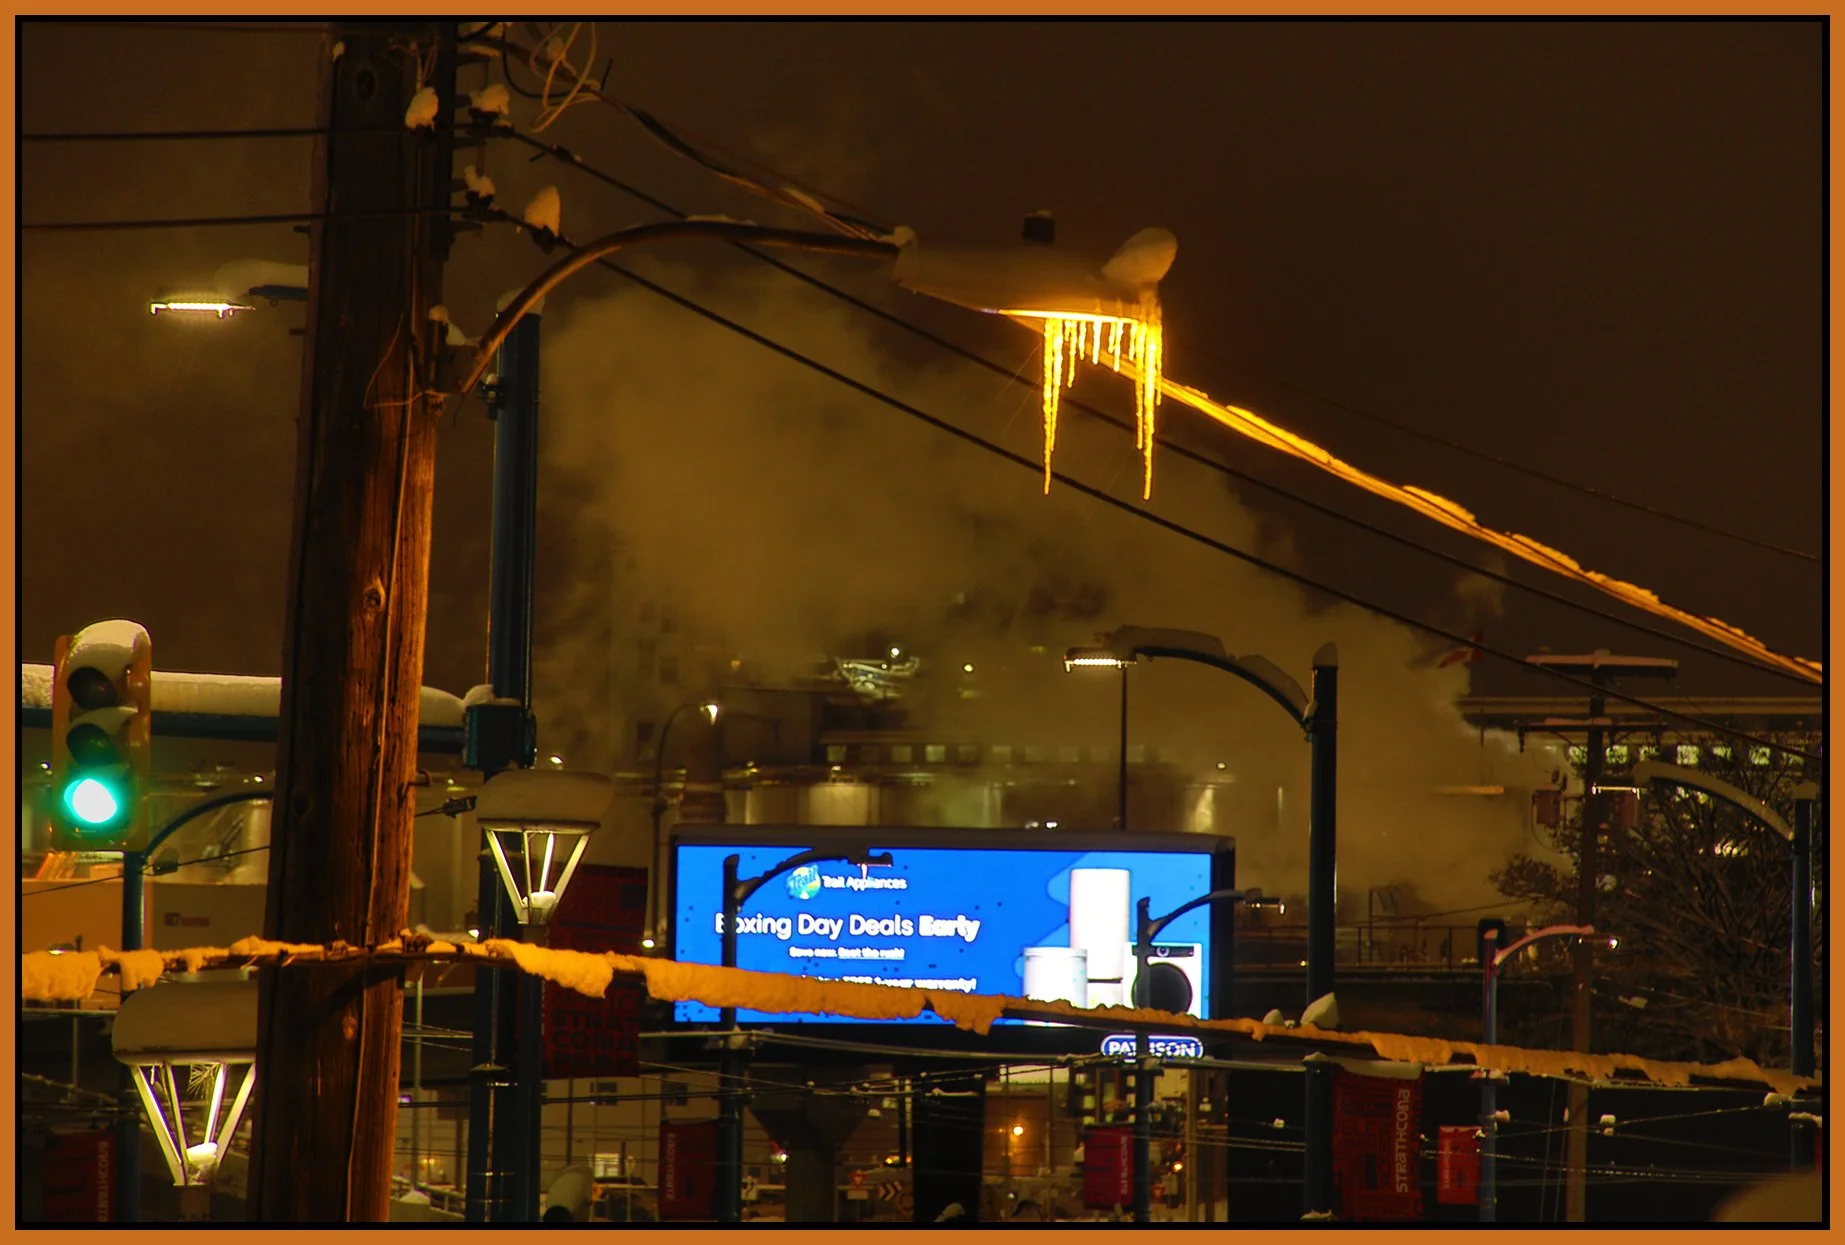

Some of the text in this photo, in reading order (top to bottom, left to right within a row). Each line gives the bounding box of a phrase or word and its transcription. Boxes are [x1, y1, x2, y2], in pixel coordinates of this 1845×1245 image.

[822, 875, 908, 892] Trail Appliances
[797, 914, 843, 940] Day
[849, 914, 914, 937] Deals
[918, 915, 981, 943] Early
